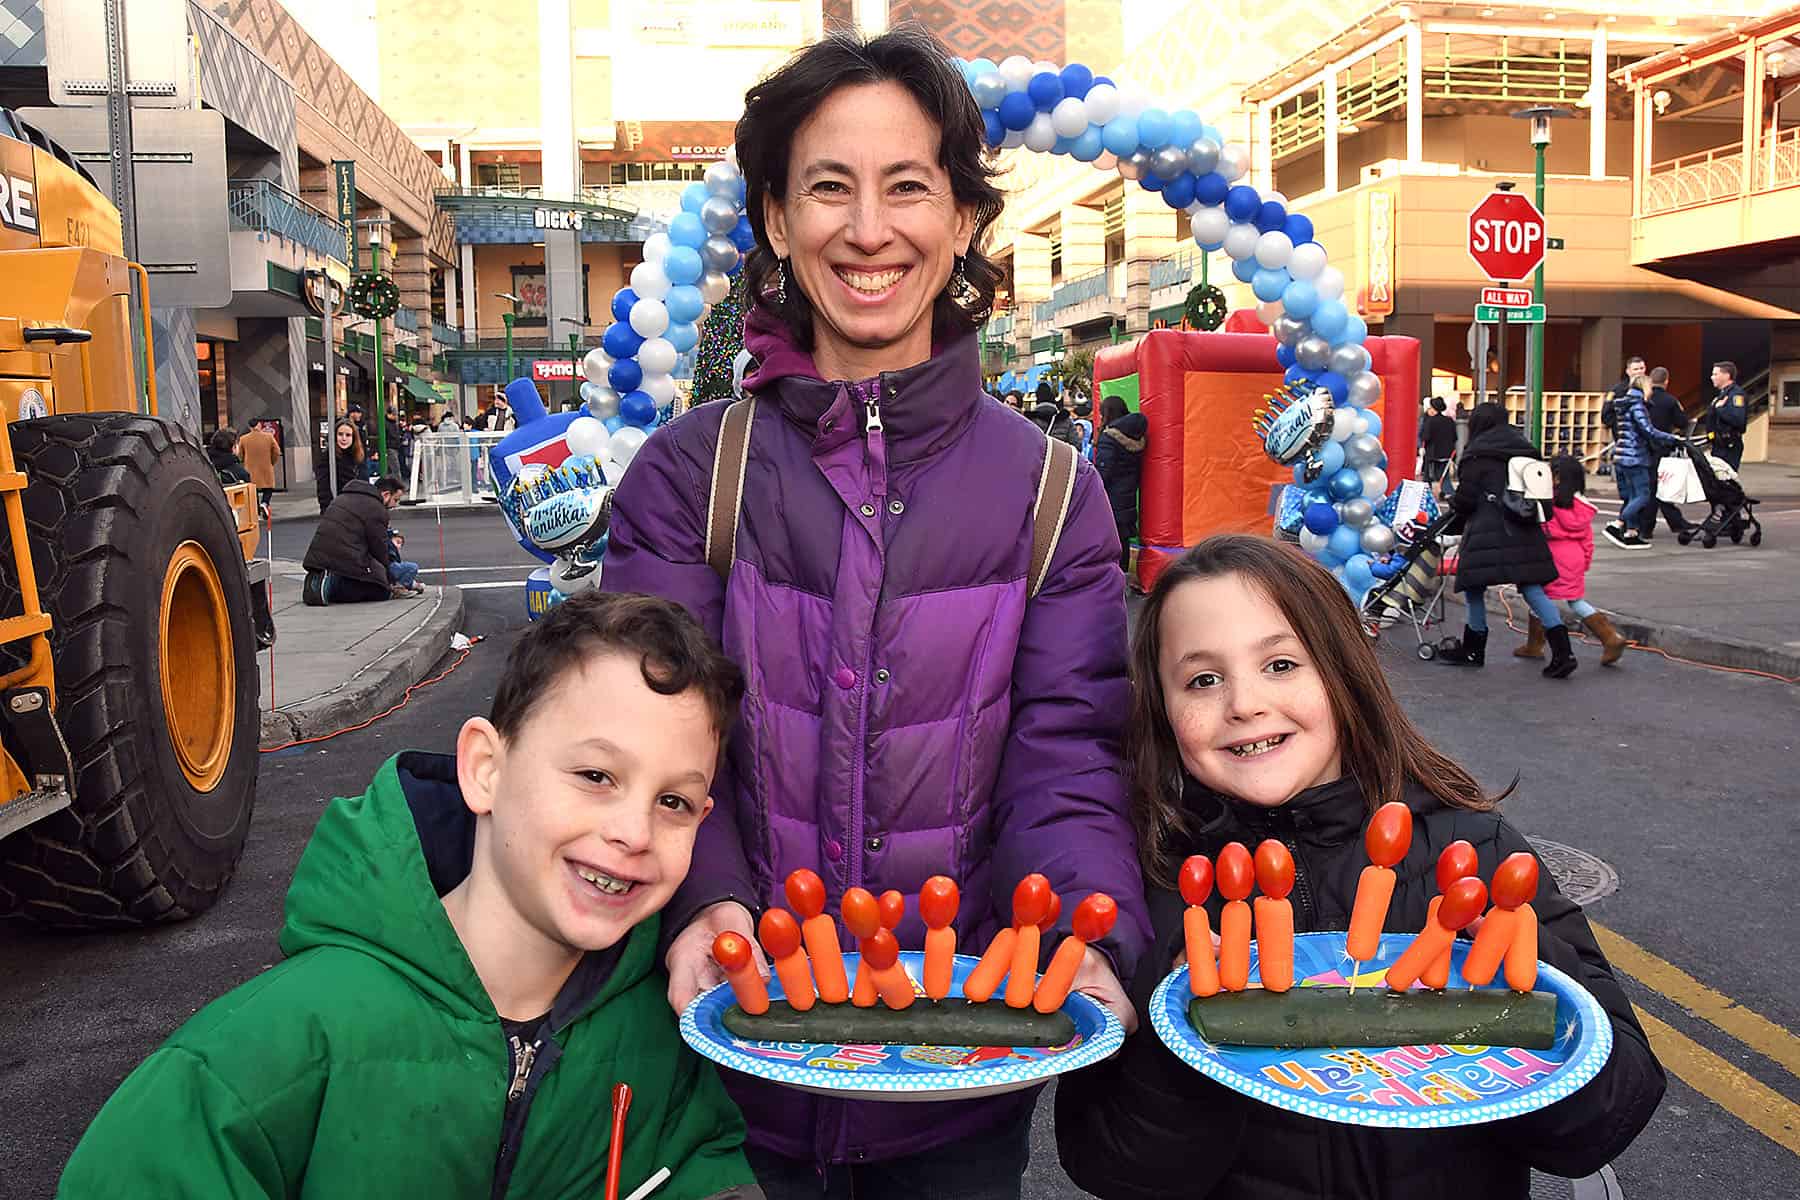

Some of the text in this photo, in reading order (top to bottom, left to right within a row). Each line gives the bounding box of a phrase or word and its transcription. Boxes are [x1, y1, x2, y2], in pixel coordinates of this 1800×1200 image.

[534, 209, 583, 230] DICK'S
[1472, 218, 1541, 254] STOP
[1486, 291, 1527, 305] ALL WAY
